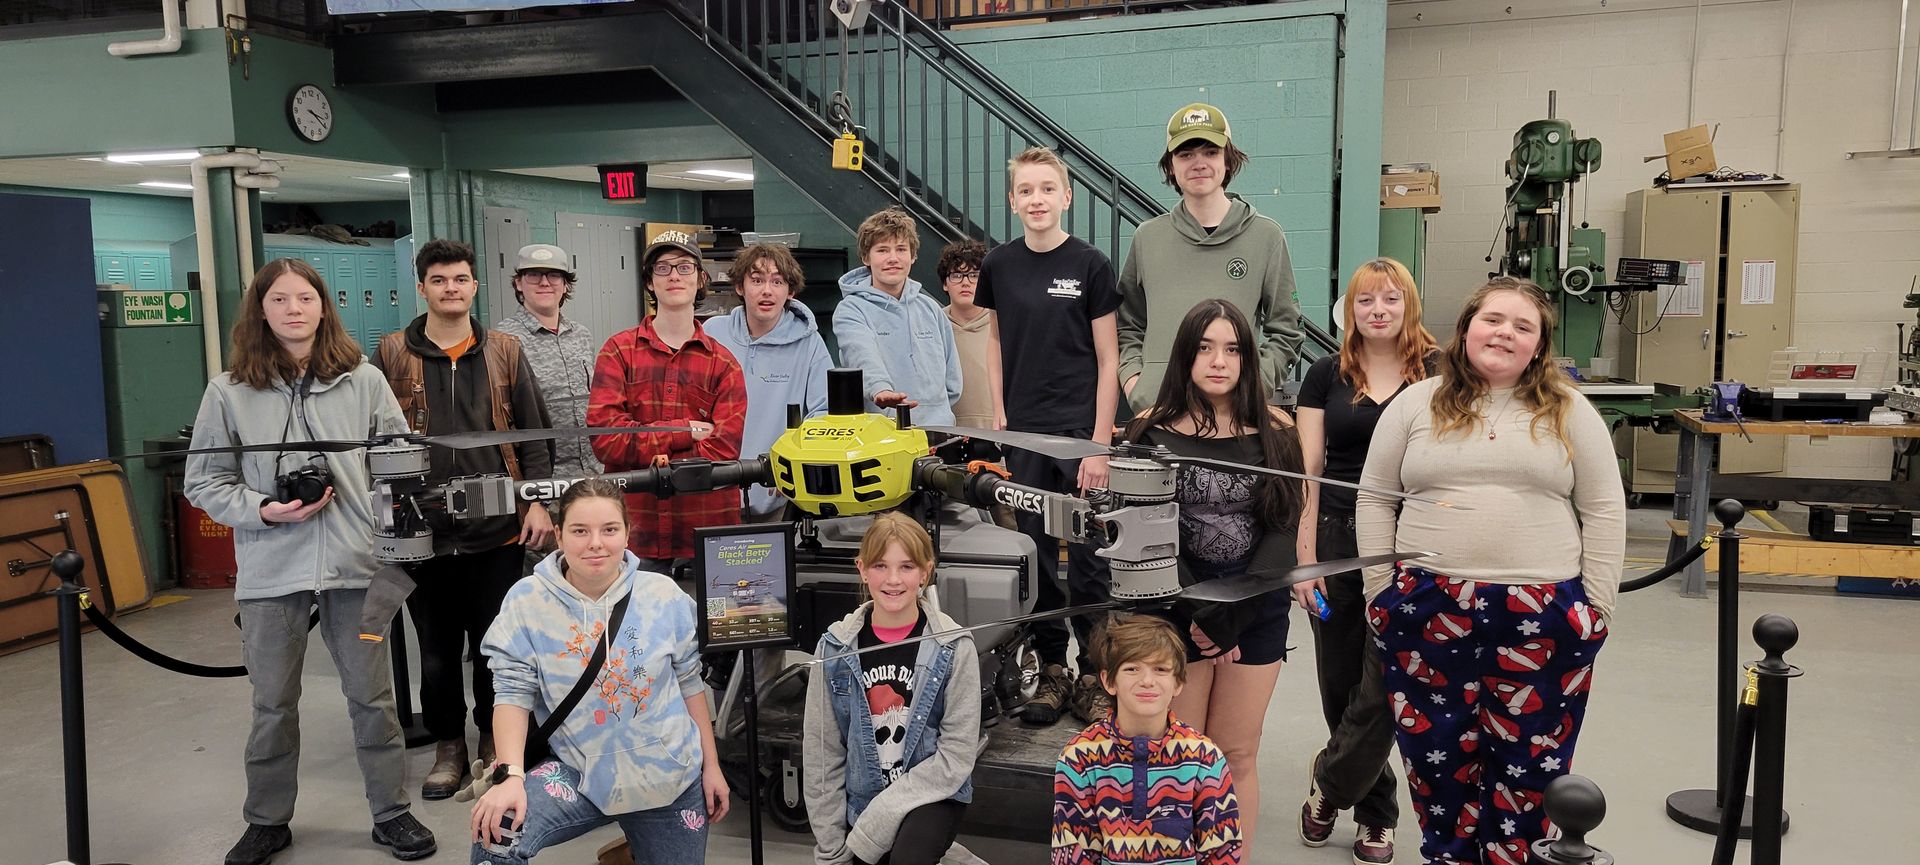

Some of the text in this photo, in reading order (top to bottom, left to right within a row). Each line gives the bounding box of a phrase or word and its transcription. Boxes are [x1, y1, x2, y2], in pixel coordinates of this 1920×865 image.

[1680, 156, 1703, 166] VEX
[607, 172, 634, 198] EXIT
[124, 296, 163, 307] EYE WASH
[126, 309, 163, 320] FOUNTAIN
[520, 477, 594, 501] CER
[718, 549, 771, 559] Black Betty
[725, 557, 763, 566] Stacked
[862, 664, 897, 689] YOUR
